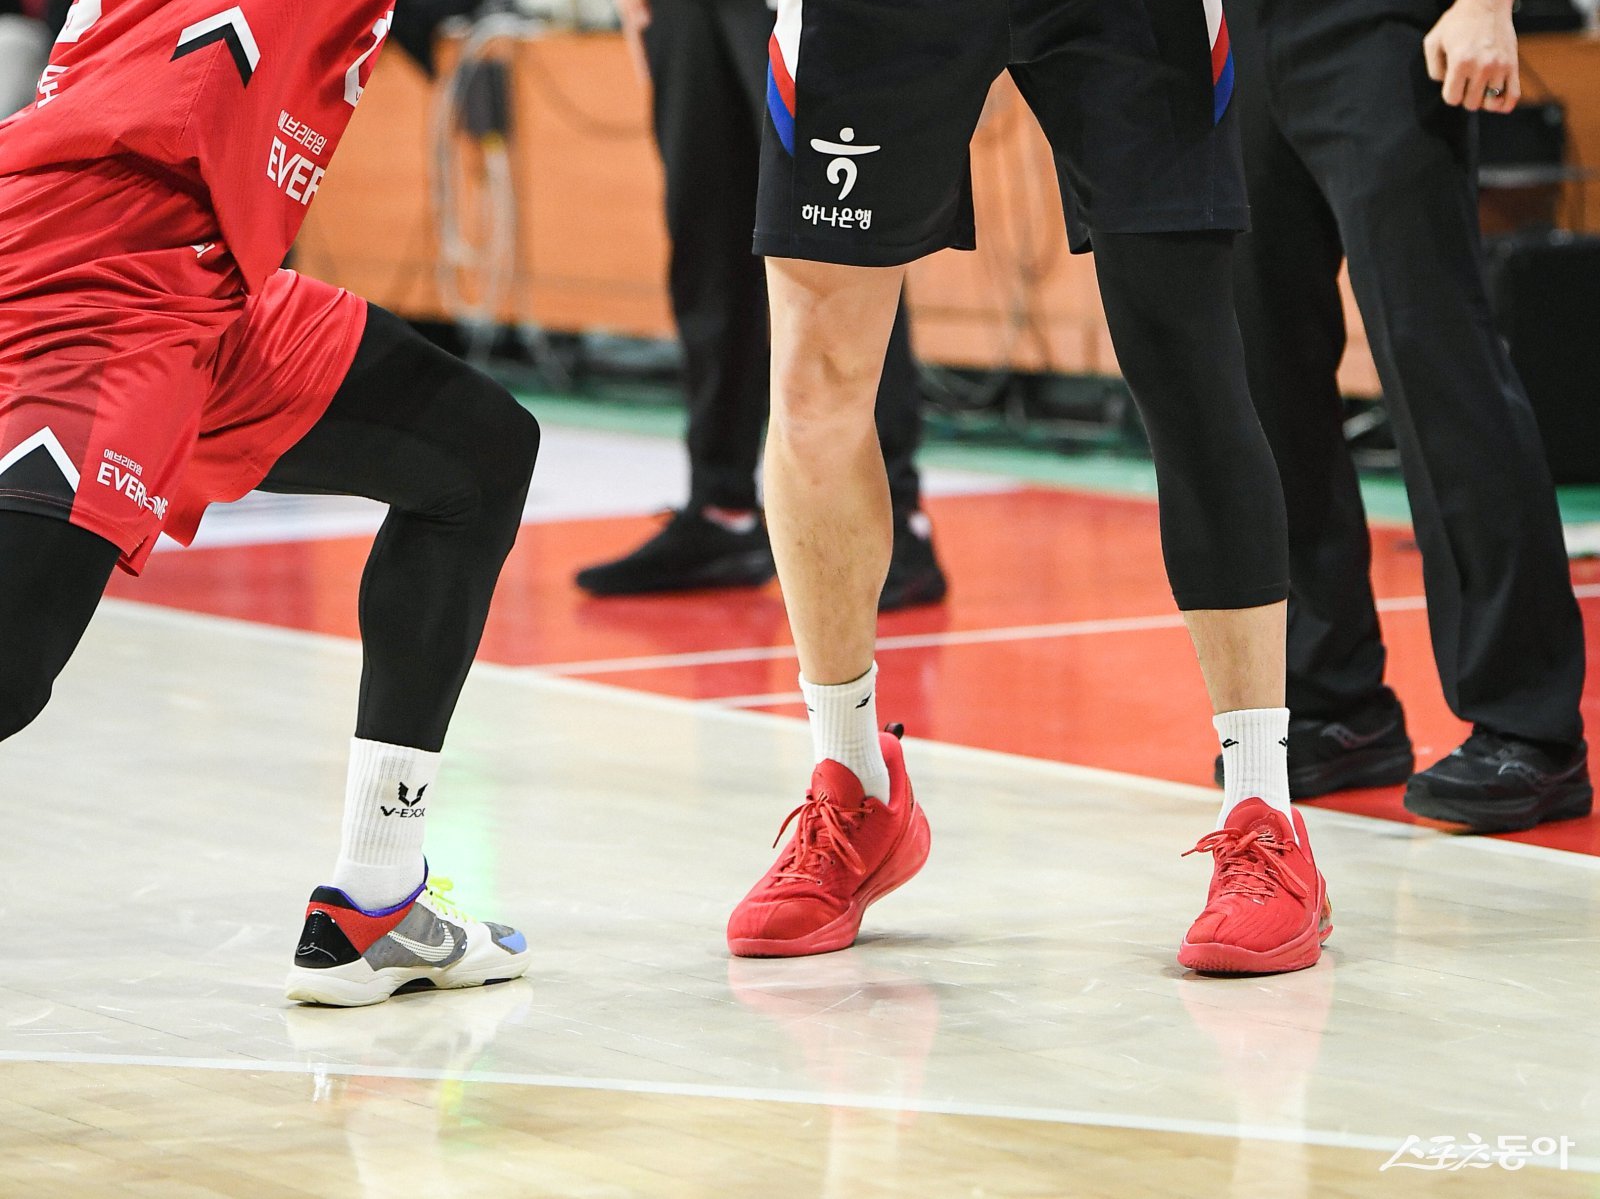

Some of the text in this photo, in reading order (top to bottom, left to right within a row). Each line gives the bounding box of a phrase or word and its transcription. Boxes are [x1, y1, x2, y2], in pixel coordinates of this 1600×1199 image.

[266, 135, 326, 206] EVER
[801, 204, 873, 230] 하나은행
[103, 448, 143, 477] 에브리타임
